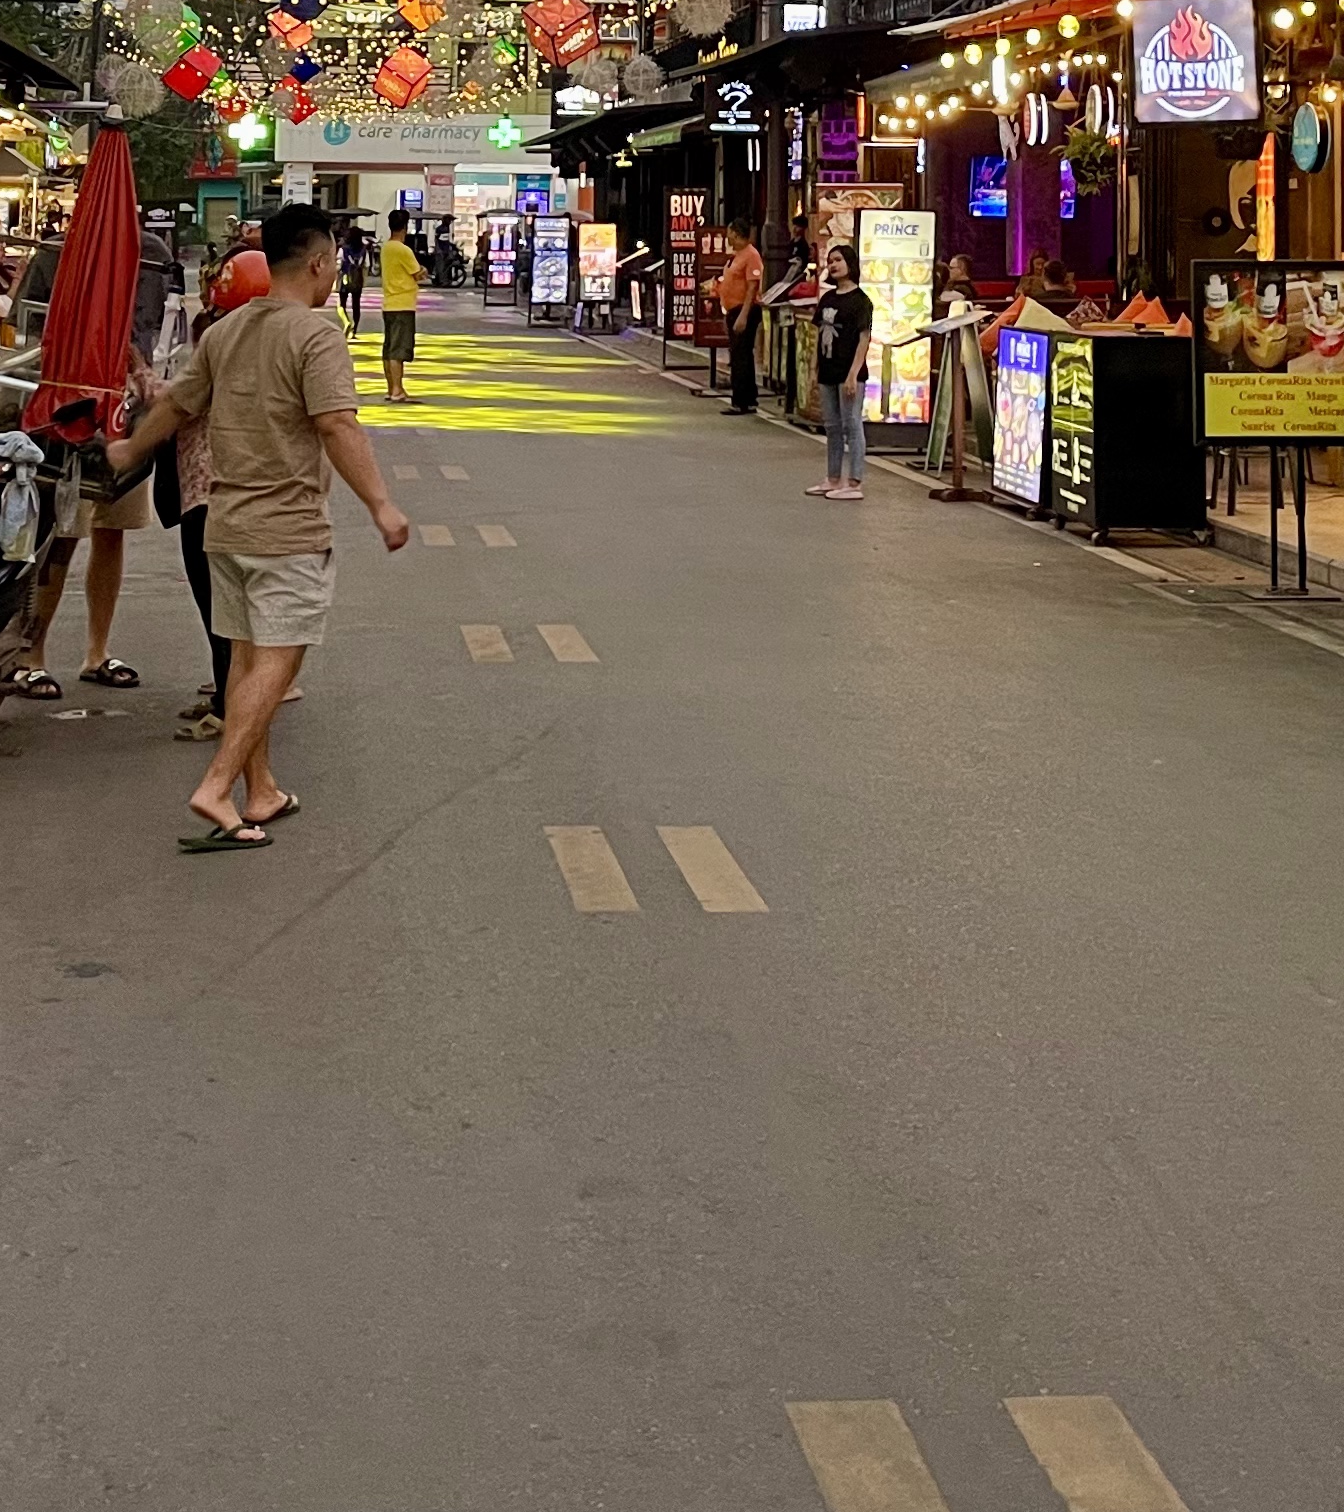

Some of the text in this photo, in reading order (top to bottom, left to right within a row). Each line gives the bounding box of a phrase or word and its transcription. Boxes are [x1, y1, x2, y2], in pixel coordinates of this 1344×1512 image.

[1140, 54, 1246, 94] HOTSTONE
[358, 124, 481, 142] care pharmacy
[670, 194, 705, 217] BUY
[670, 231, 696, 241] BUCKE
[873, 223, 920, 237] PRINCE
[673, 253, 696, 264] DRAF
[673, 264, 694, 276] BEE
[1209, 376, 1256, 388] Margarita
[1258, 376, 1312, 386] CoronaRita
[1239, 391, 1273, 401] Corona
[1276, 391, 1296, 401] Rita
[1230, 406, 1284, 416] CoronaRita
[1241, 421, 1337, 432] Sunrise CoronaRita
